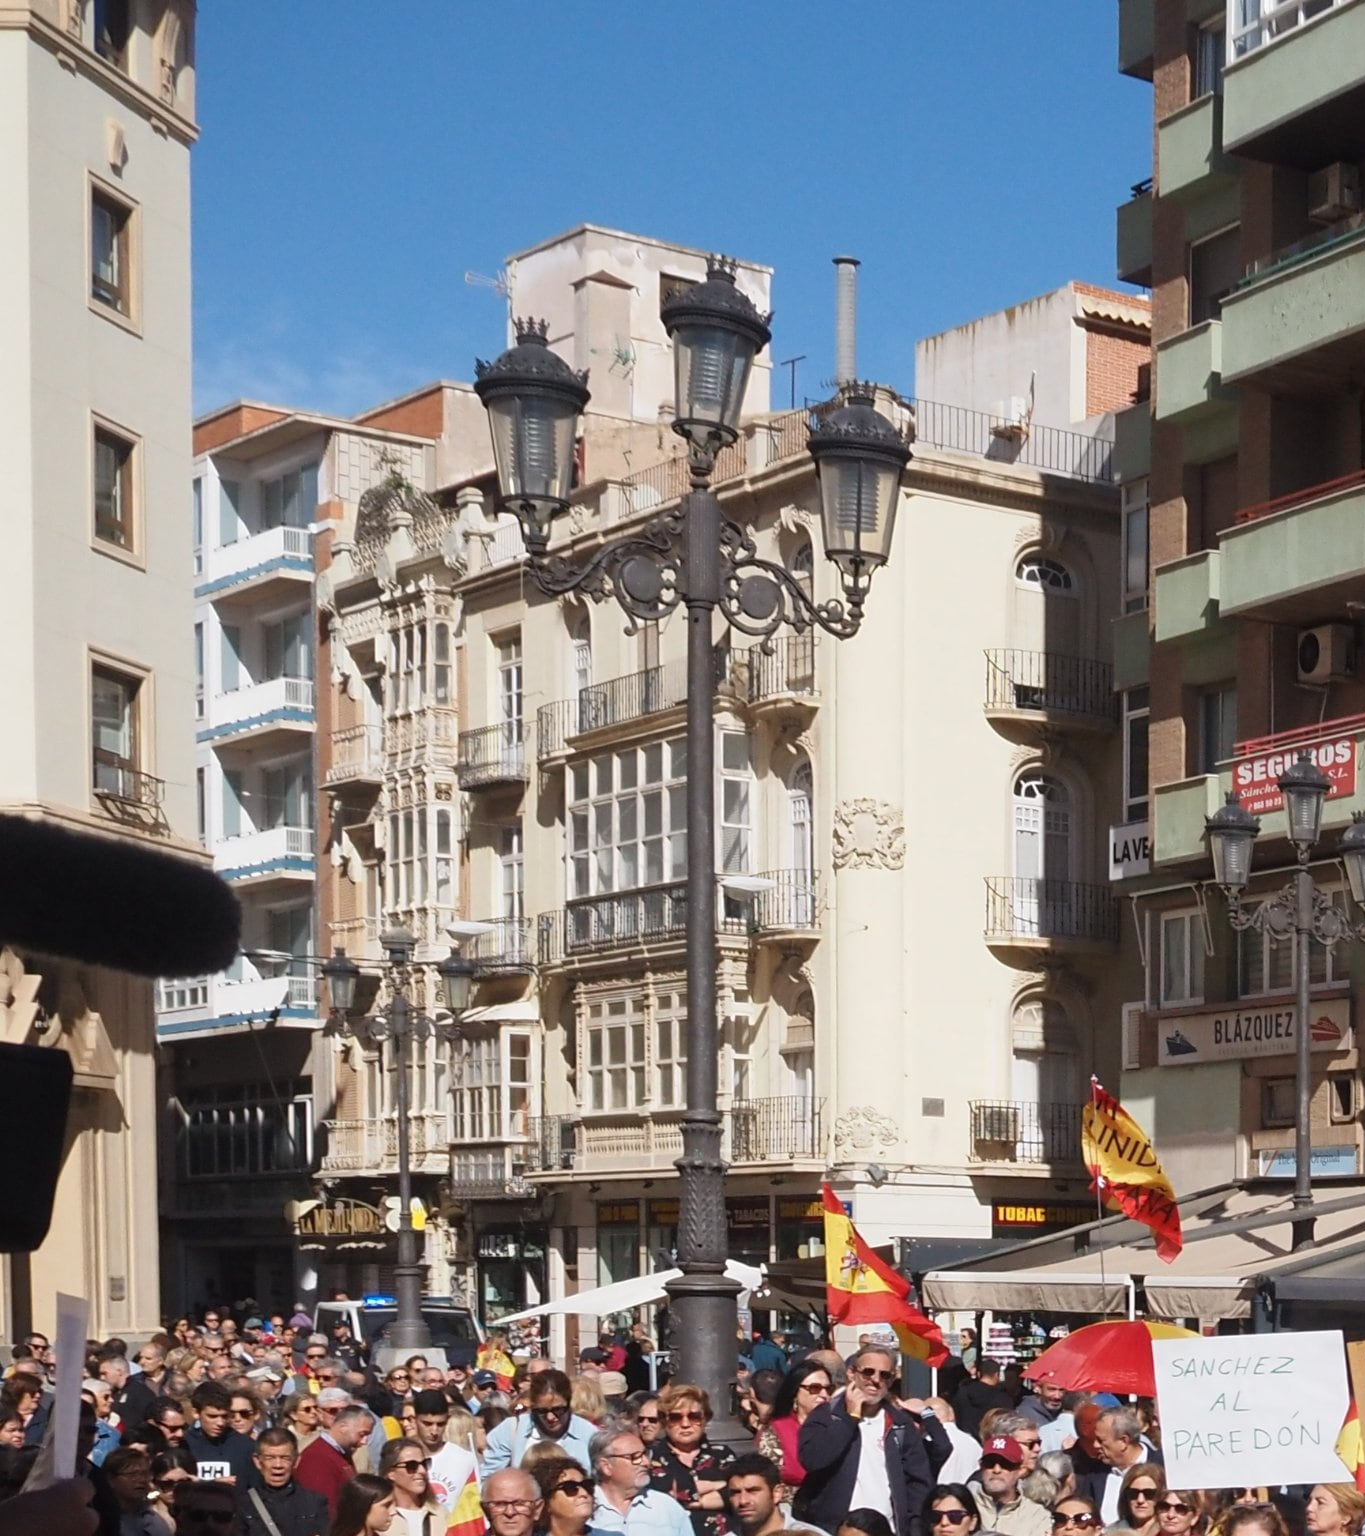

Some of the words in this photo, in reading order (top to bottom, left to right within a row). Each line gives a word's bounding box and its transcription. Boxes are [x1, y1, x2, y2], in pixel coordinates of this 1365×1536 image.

[1214, 1011, 1294, 1045] BLÁZQUEZ
[1171, 1356, 1294, 1378] SANCHEZ
[1209, 1390, 1250, 1412] AL
[1173, 1410, 1321, 1460] PAREDÓN
[201, 1466, 224, 1478] HH
